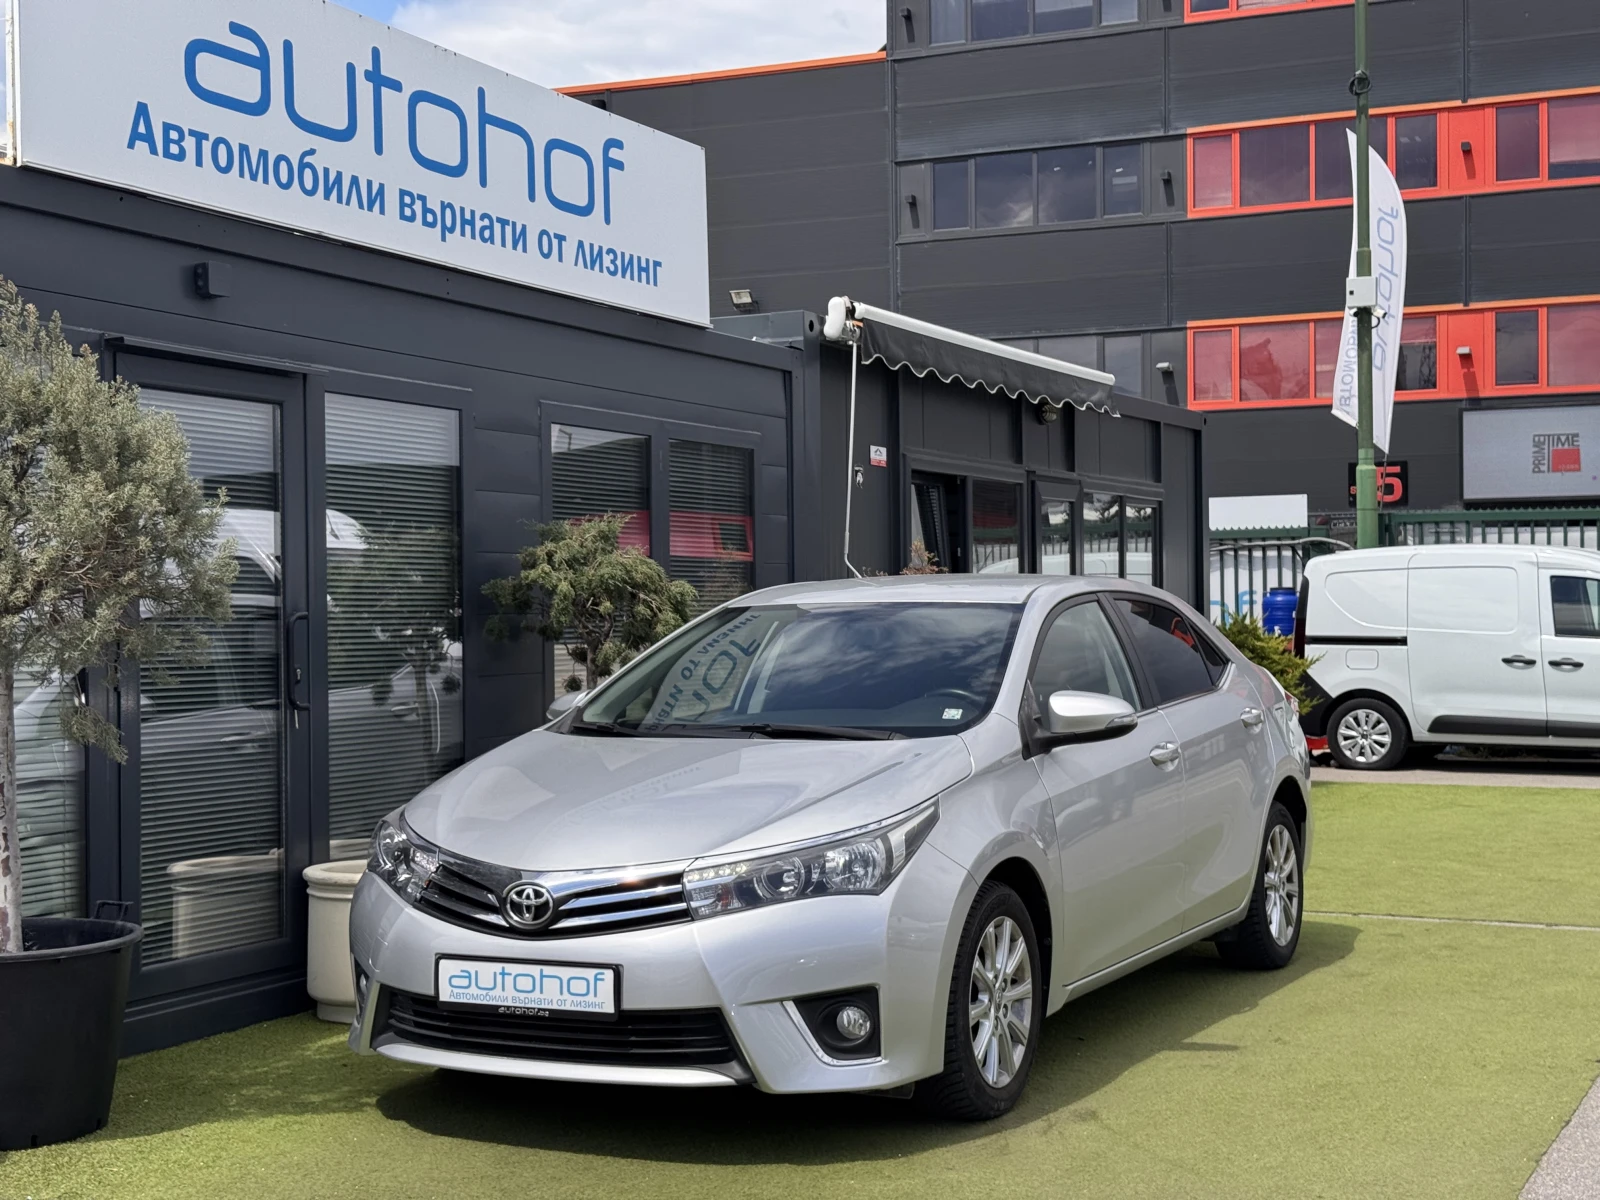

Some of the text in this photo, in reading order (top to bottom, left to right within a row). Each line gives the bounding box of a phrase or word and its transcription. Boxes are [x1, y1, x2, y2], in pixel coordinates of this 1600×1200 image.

[184, 20, 625, 225] autohof
[126, 100, 663, 287] Автомобили върнати от лизинг
[1531, 433, 1546, 474] PRIME
[448, 966, 606, 998] autohof
[449, 989, 606, 1010] Автомобили върнати от лизинг
